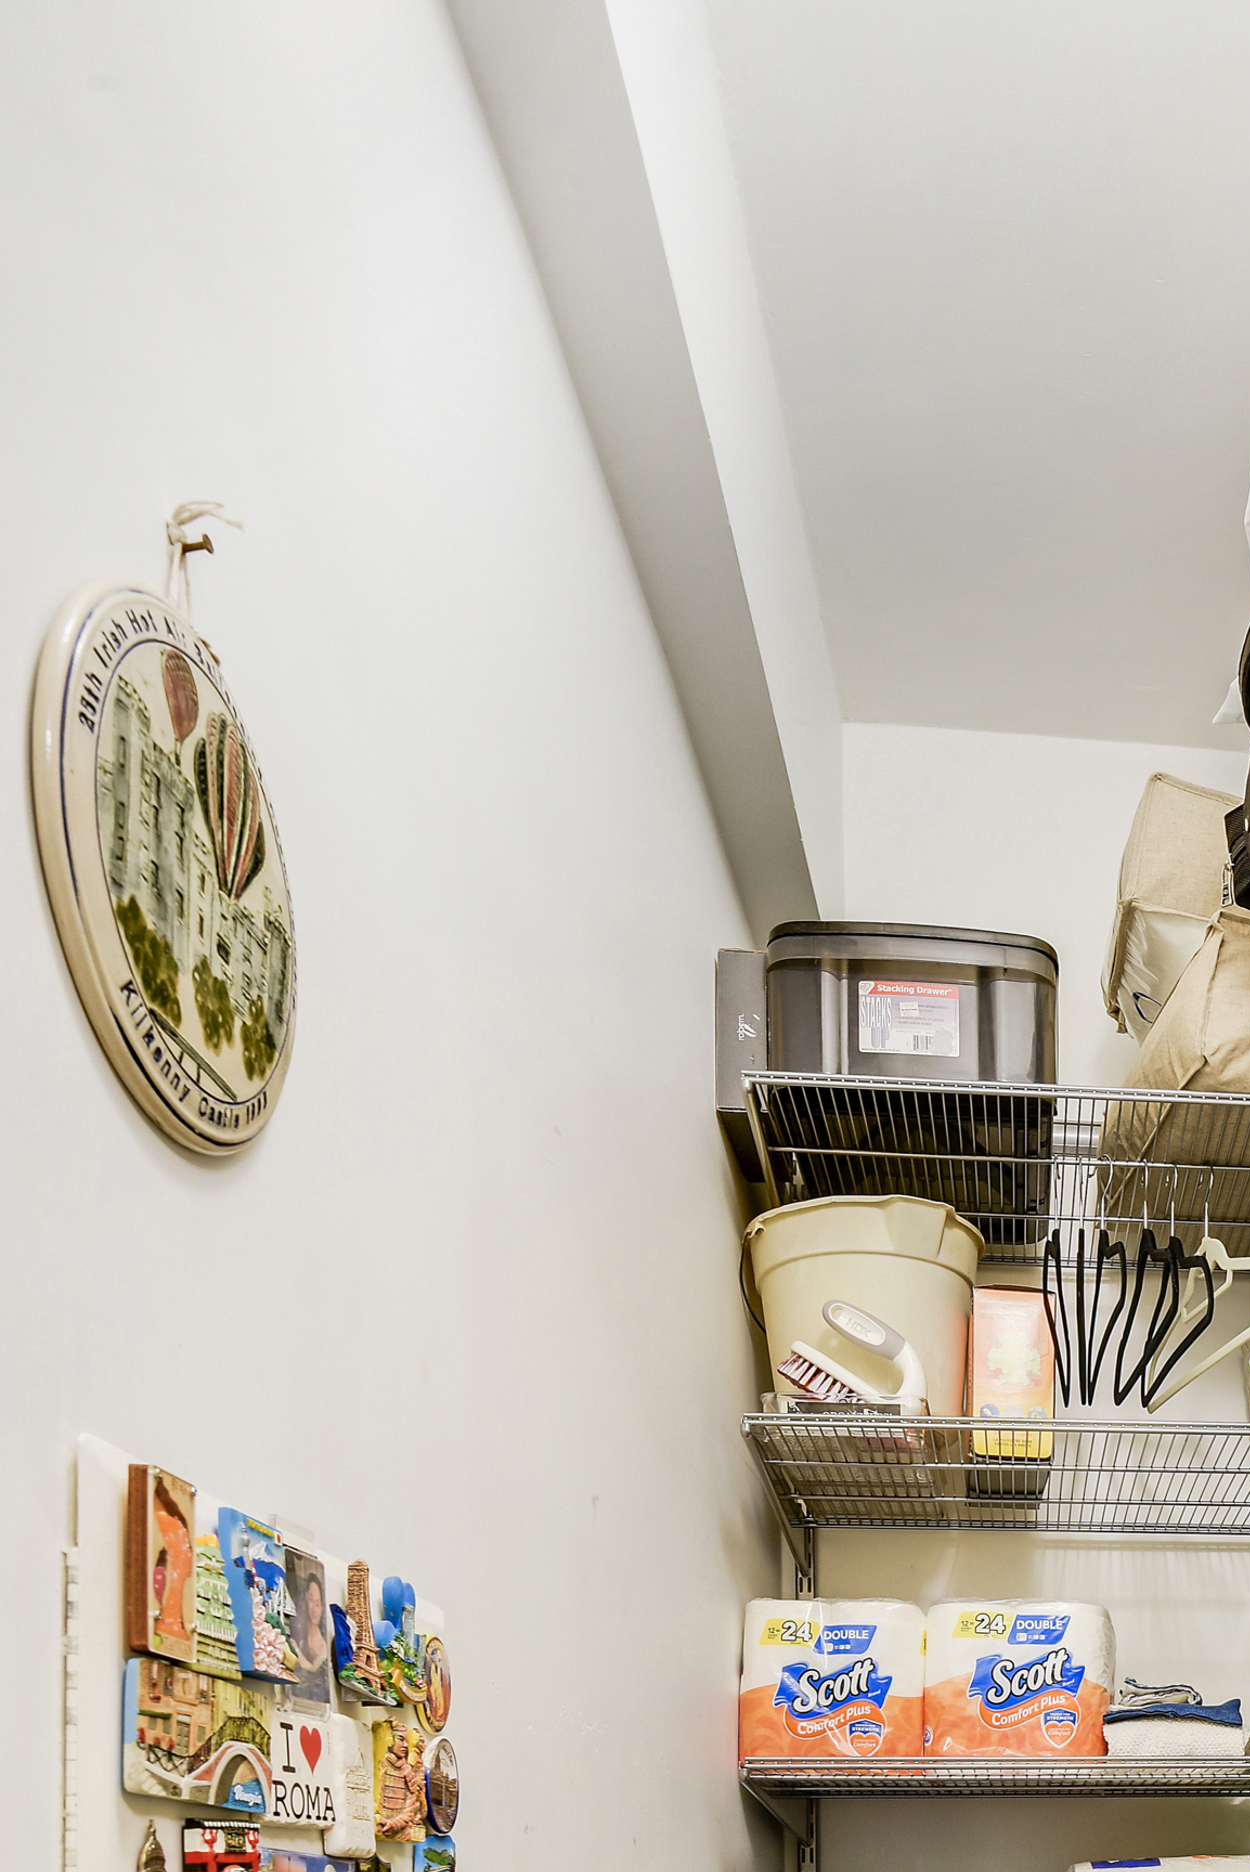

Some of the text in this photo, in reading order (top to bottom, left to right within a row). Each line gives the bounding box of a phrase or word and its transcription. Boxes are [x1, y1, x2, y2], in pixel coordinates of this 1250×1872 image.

[93, 619, 128, 668] Irish
[125, 609, 158, 634] Hot
[877, 984, 914, 995] Stacking
[860, 996, 892, 1027] STACKS
[870, 1027, 890, 1048] UP
[120, 980, 239, 1128] Kilkenny Castle
[846, 1317, 872, 1338] HDX
[781, 1620, 812, 1642] 24
[823, 1630, 869, 1640] DOUBLE
[974, 1612, 1006, 1634] 24
[1016, 1619, 1063, 1630] DOUBLE
[792, 1657, 875, 1714] Scott
[985, 1648, 1068, 1704] Scott
[797, 1705, 871, 1735] Comfort Plus
[991, 1694, 1066, 1726] Comfort Plus
[279, 1722, 296, 1773] I
[272, 1780, 336, 1822] ROMA
